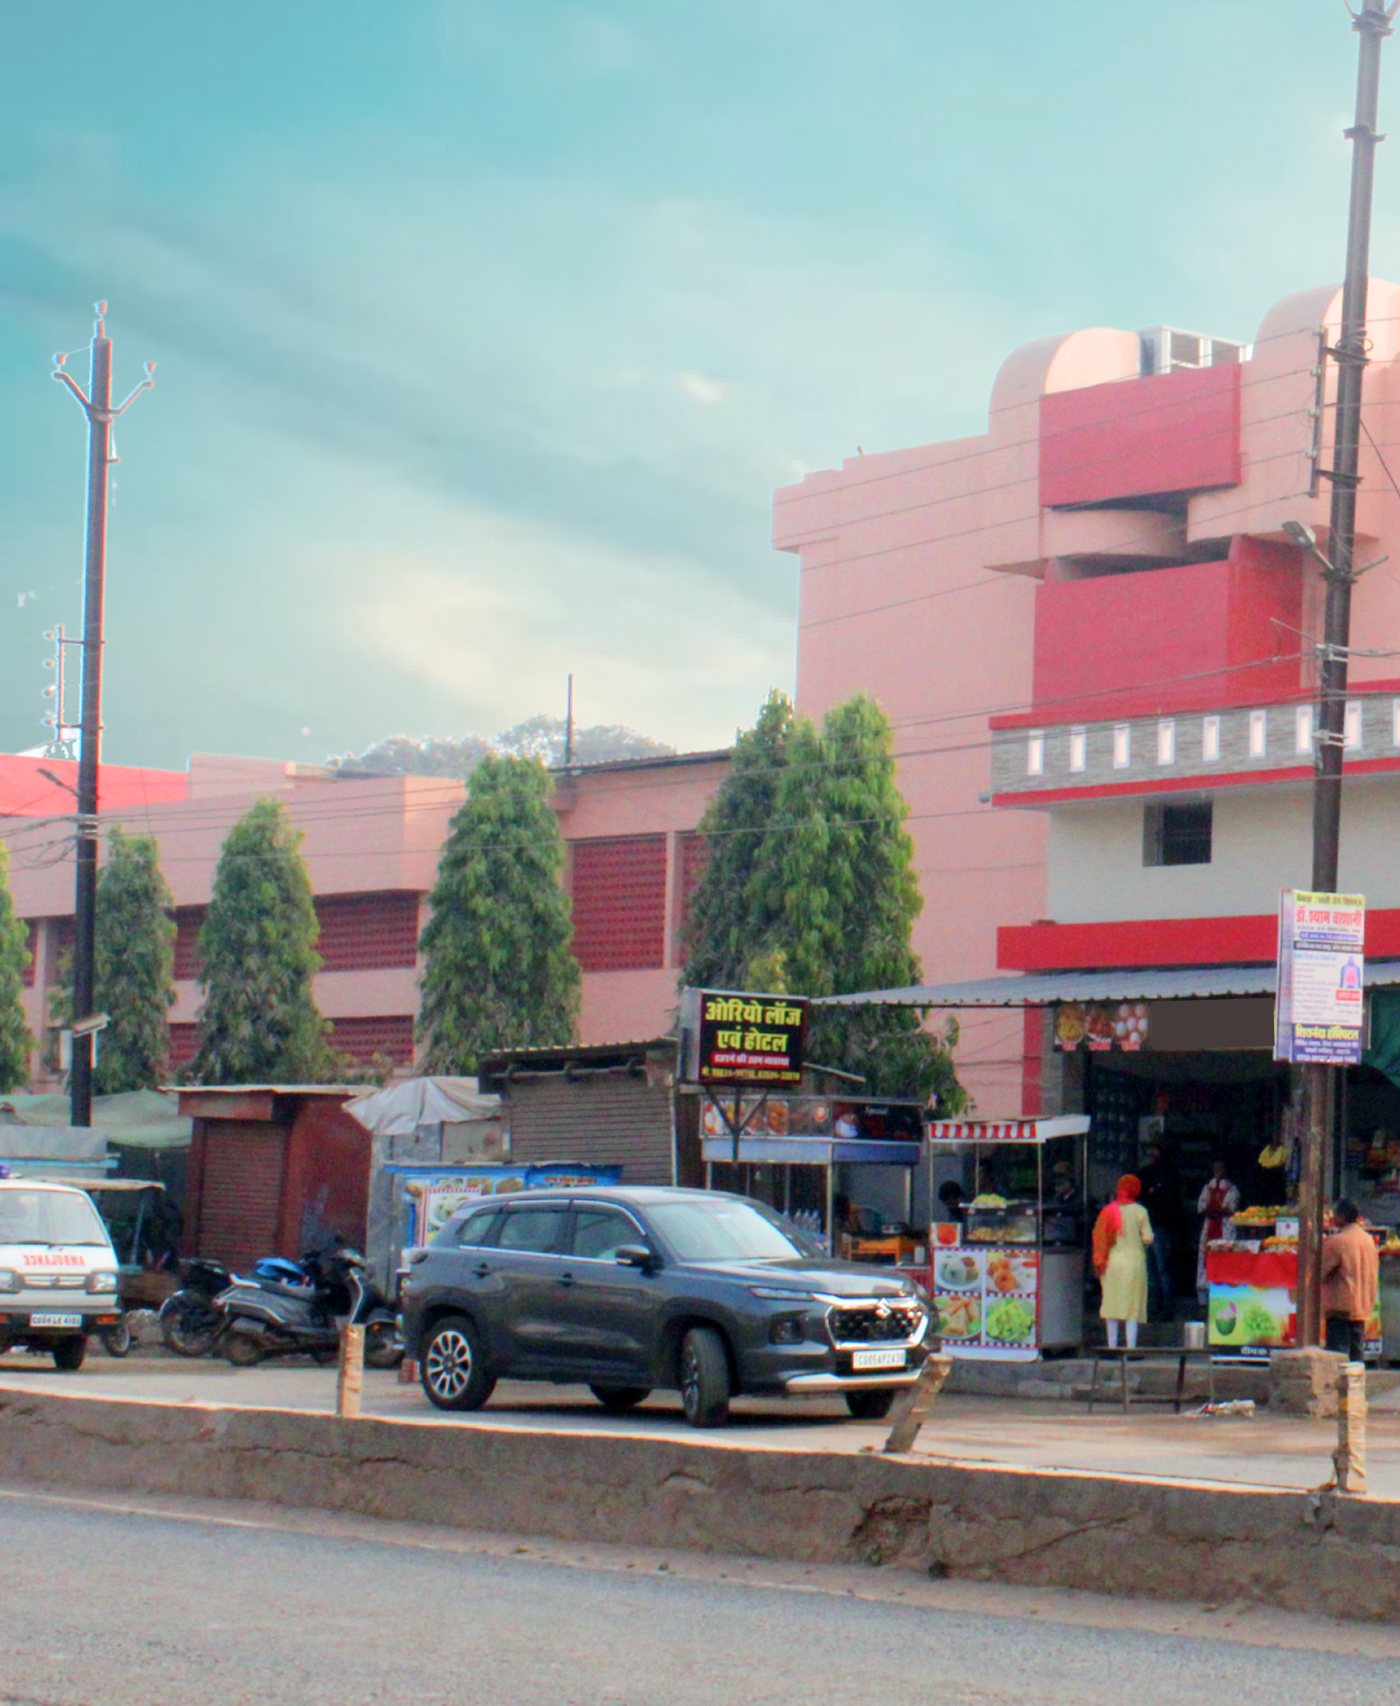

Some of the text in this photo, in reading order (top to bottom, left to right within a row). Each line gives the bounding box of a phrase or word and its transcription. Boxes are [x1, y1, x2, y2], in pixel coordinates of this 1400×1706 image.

[705, 997, 802, 1026] ओरियो लॉज
[717, 1025, 789, 1052] एवं होटल
